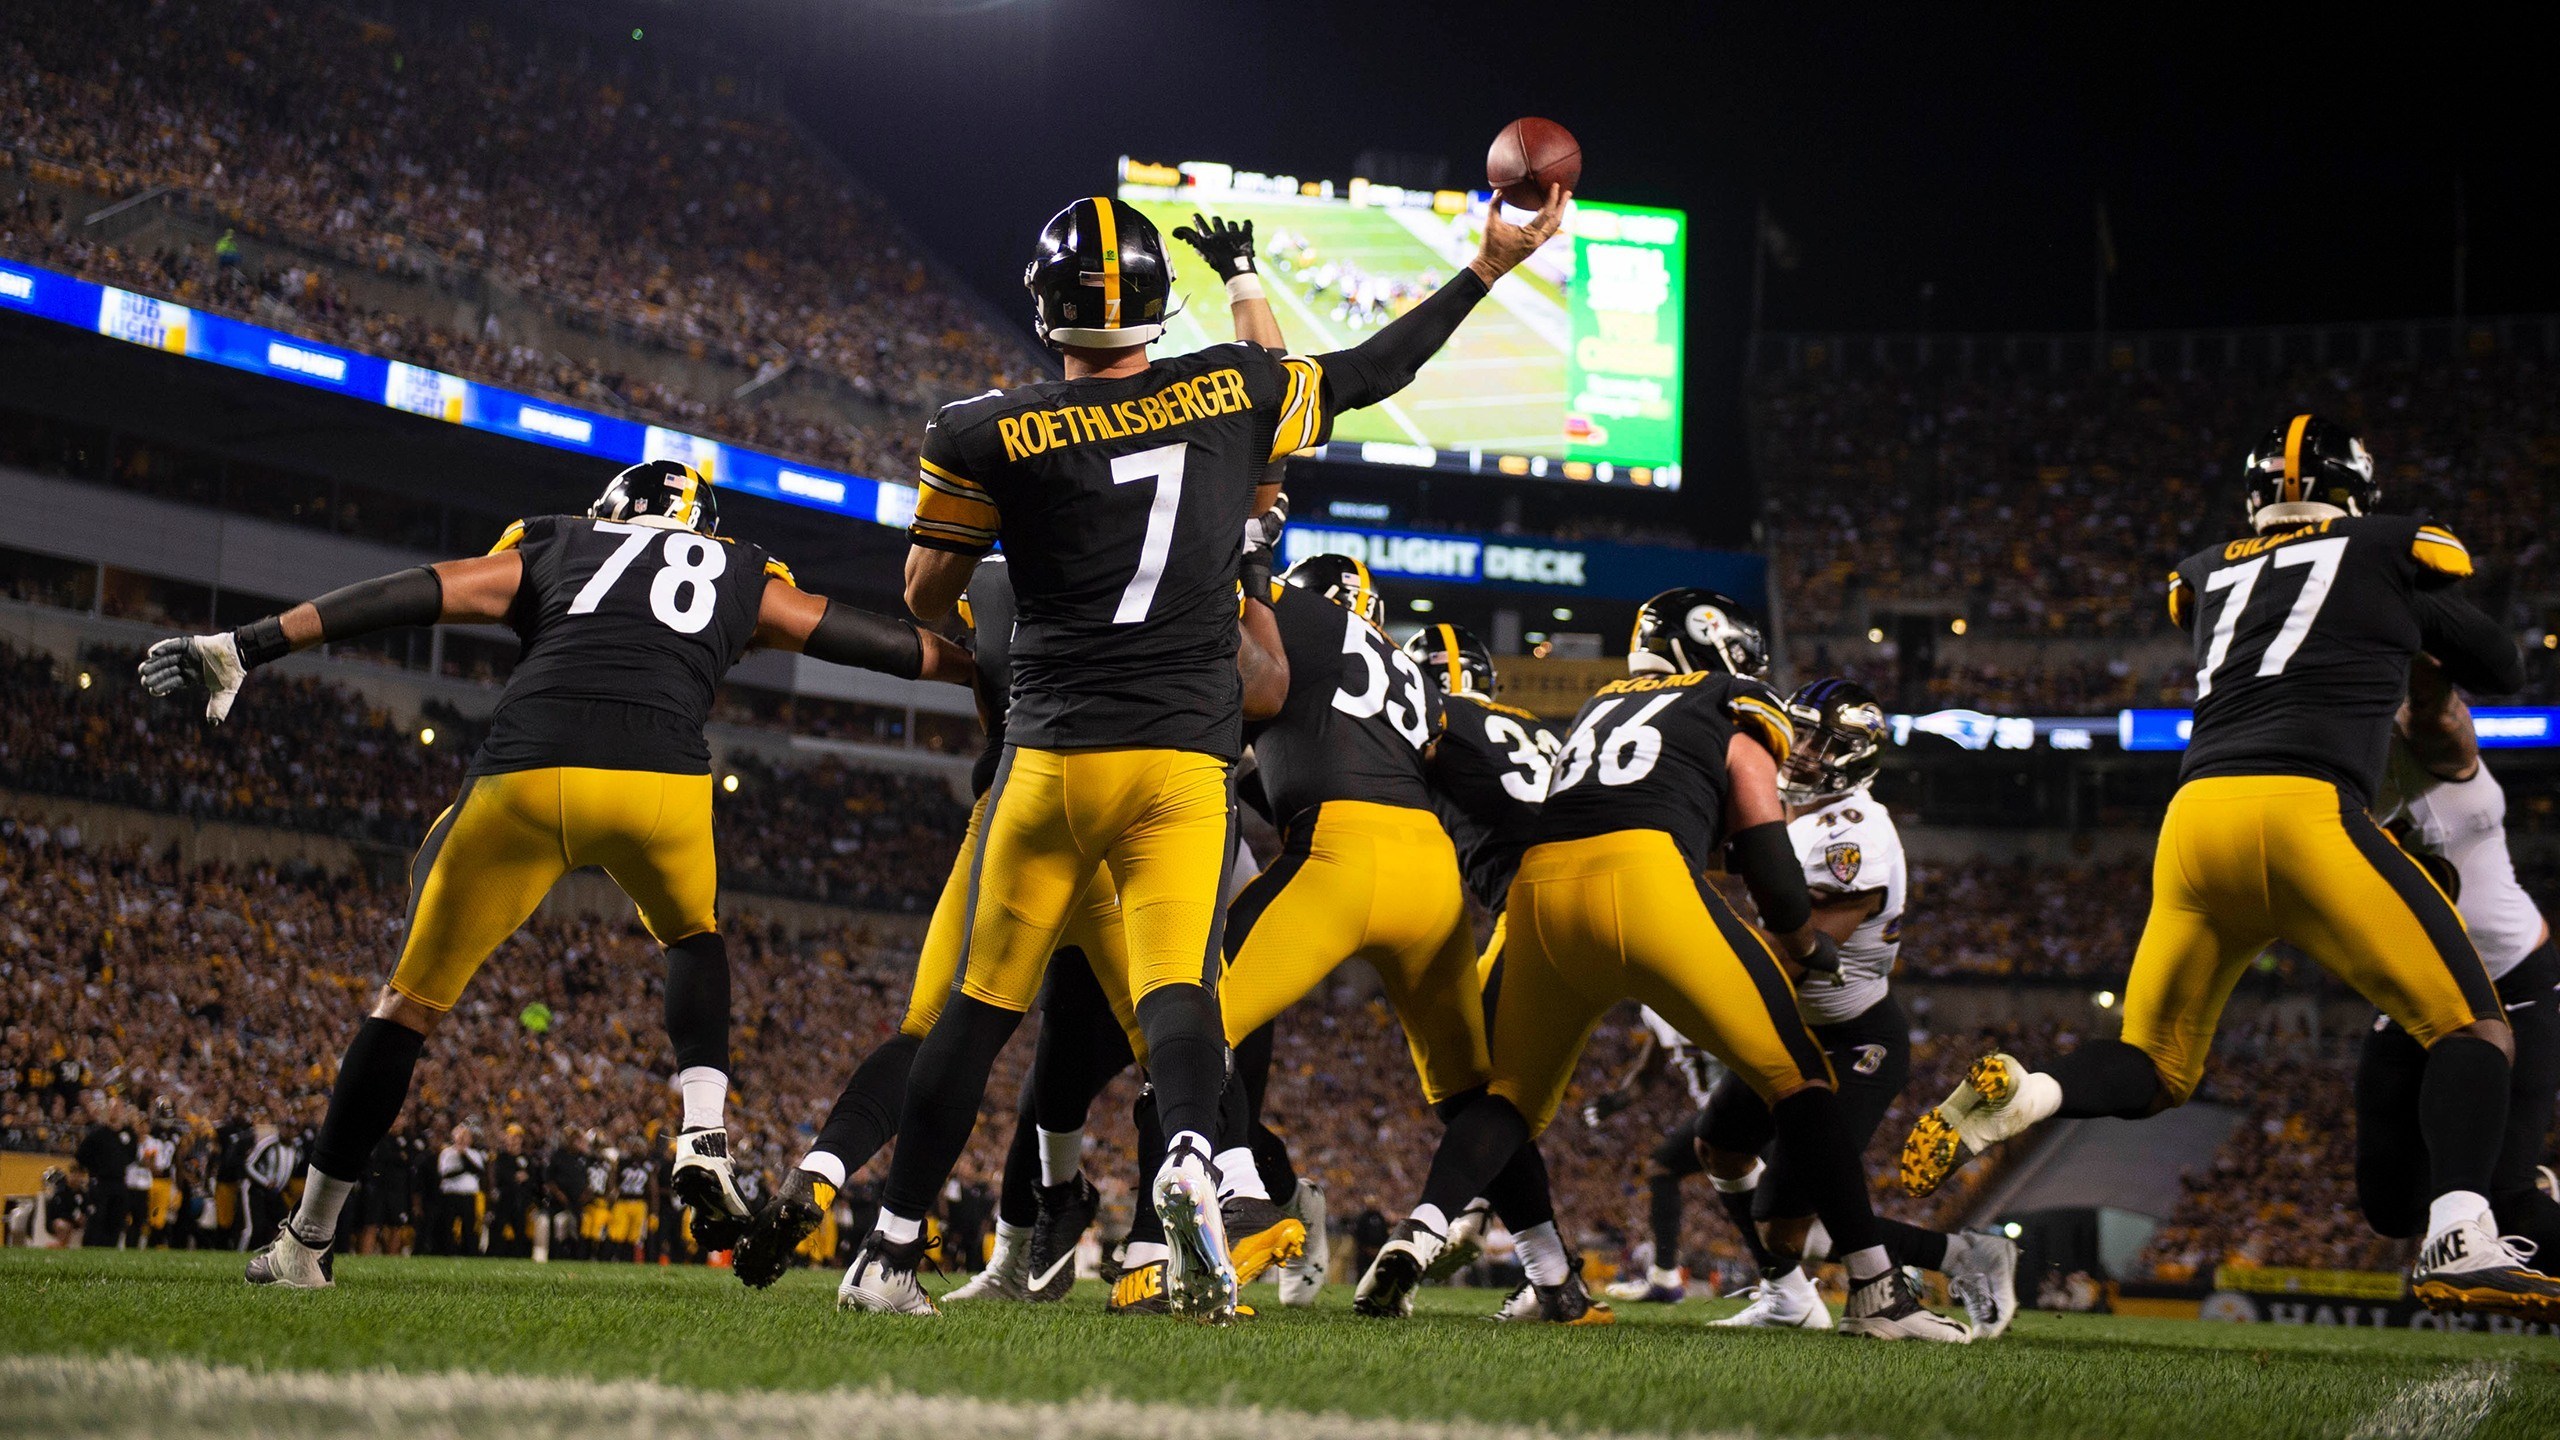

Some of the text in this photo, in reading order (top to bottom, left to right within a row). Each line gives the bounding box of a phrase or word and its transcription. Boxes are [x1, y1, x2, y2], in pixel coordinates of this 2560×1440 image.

[1104, 299, 1121, 328] 7
[998, 369, 1252, 462] ROETHLISBERGER
[2272, 477, 2316, 503] 77
[1110, 441, 1188, 624] 7
[1285, 527, 1586, 586] BUD LIGHT DECK
[2224, 518, 2332, 560] GILT
[567, 520, 727, 634] 78
[1347, 588, 1376, 620] 53
[2195, 536, 2349, 701] 77
[1331, 611, 1429, 749] 53
[1439, 669, 1473, 694] 30
[1548, 692, 1683, 797] 66
[2418, 1228, 2469, 1272] NIKE
[1111, 1265, 1163, 1307] NIKE
